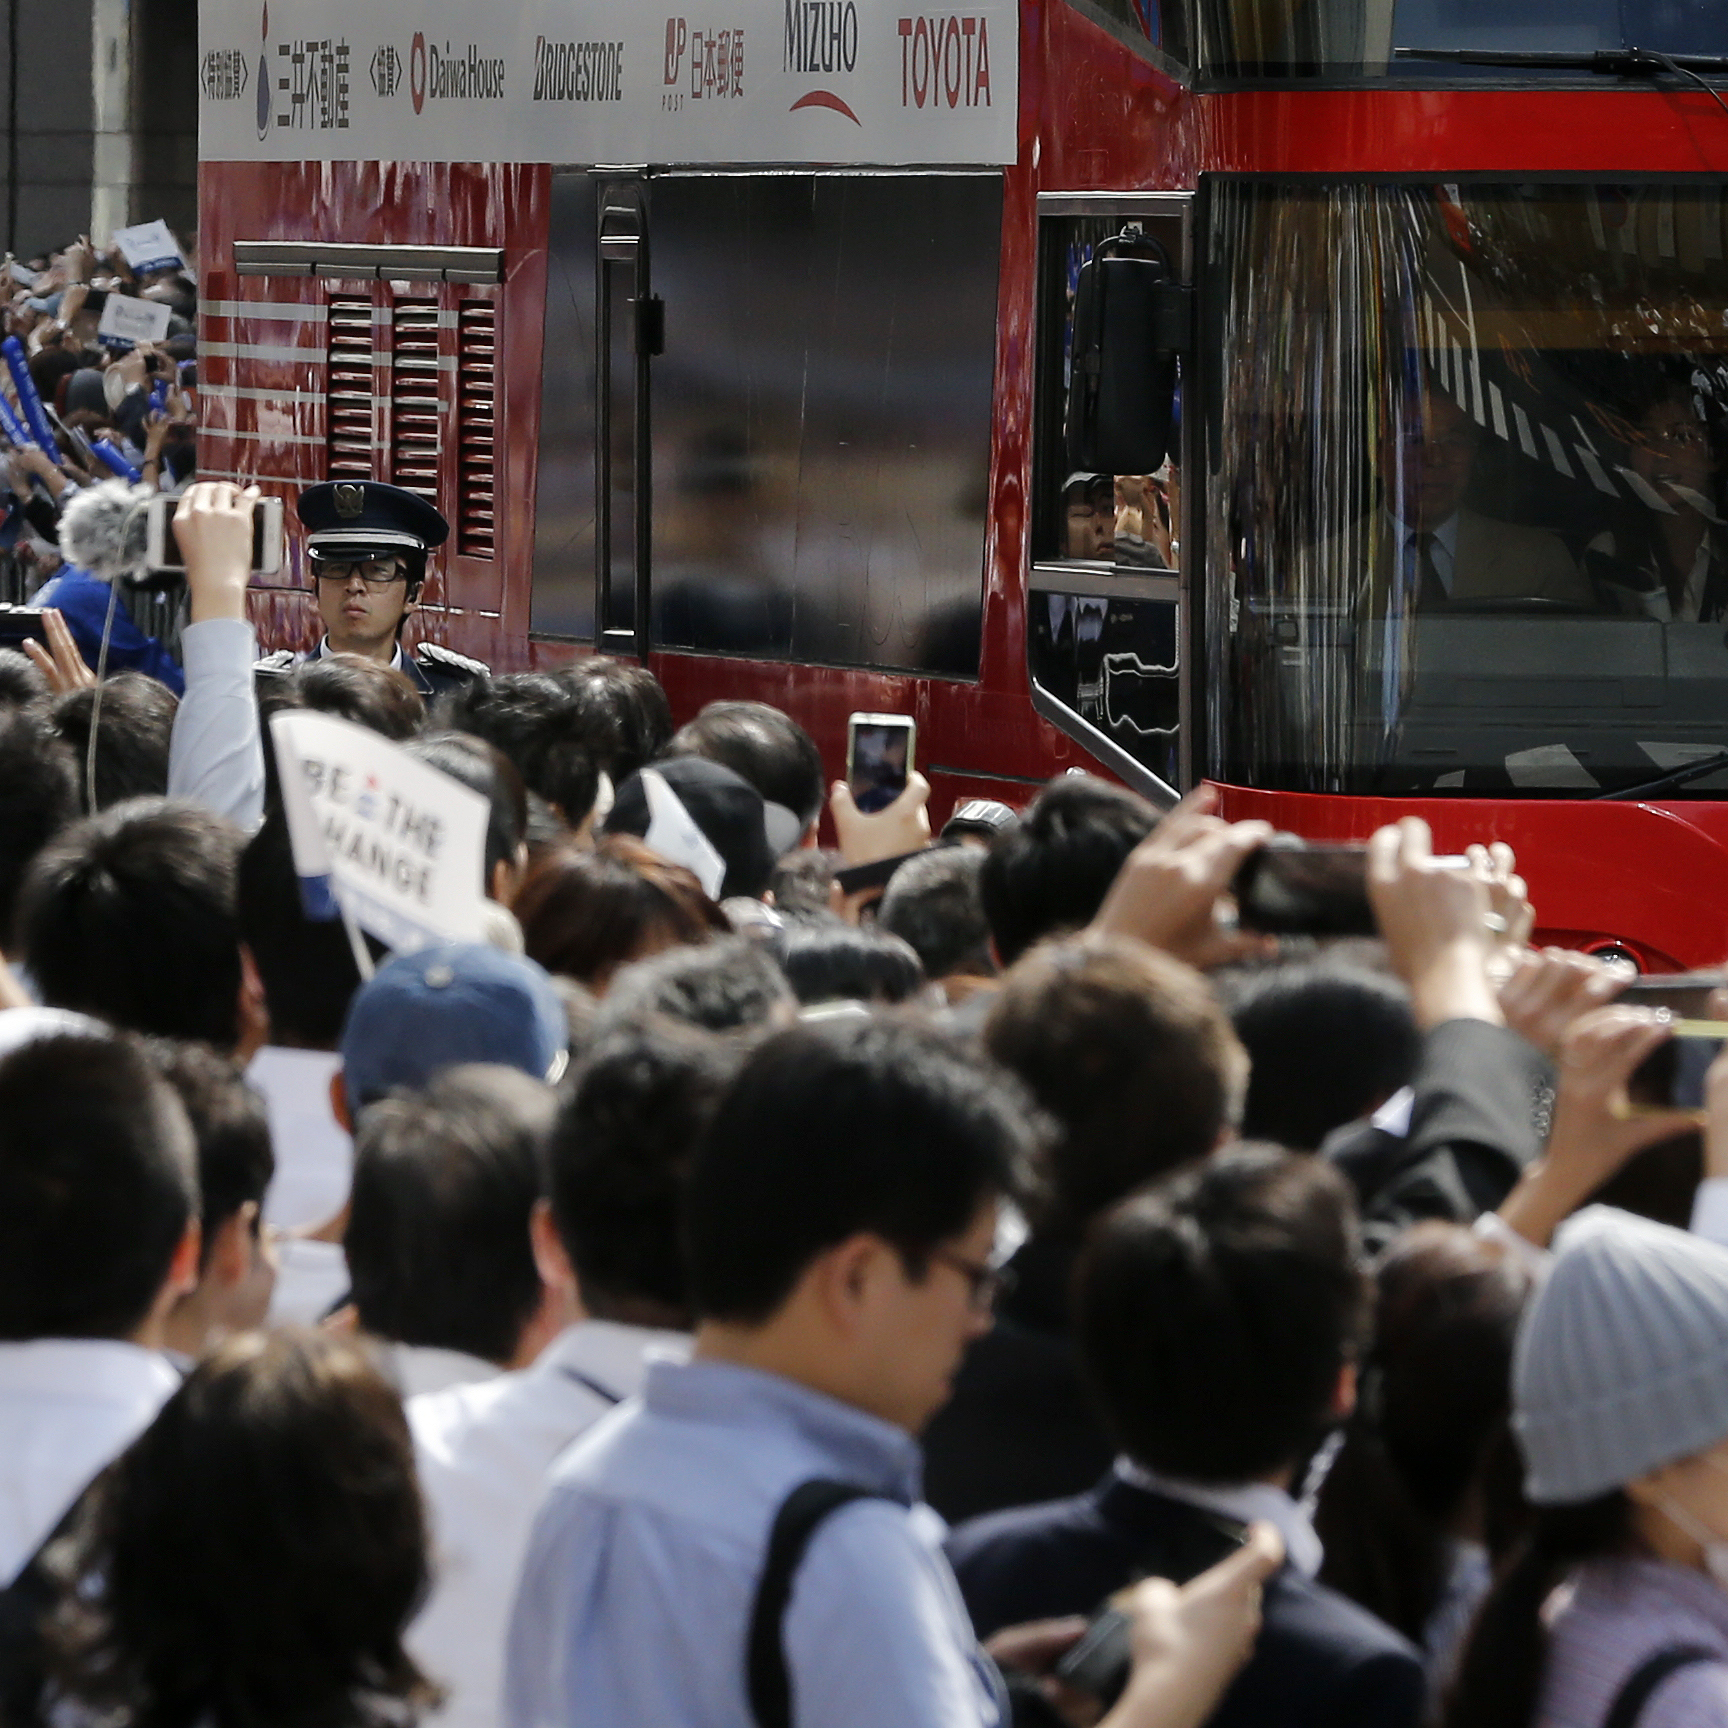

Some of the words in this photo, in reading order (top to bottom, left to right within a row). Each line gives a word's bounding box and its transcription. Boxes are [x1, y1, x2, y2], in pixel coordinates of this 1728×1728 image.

[277, 37, 349, 129] 三井不動産
[533, 35, 624, 102] BRIDGESTONE
[661, 94, 684, 112] POST
[691, 28, 745, 100] 日本郵便
[897, 15, 992, 109] TOYOTA
[302, 759, 350, 803] BE
[387, 792, 444, 857] THE
[324, 817, 432, 906] HANGE
